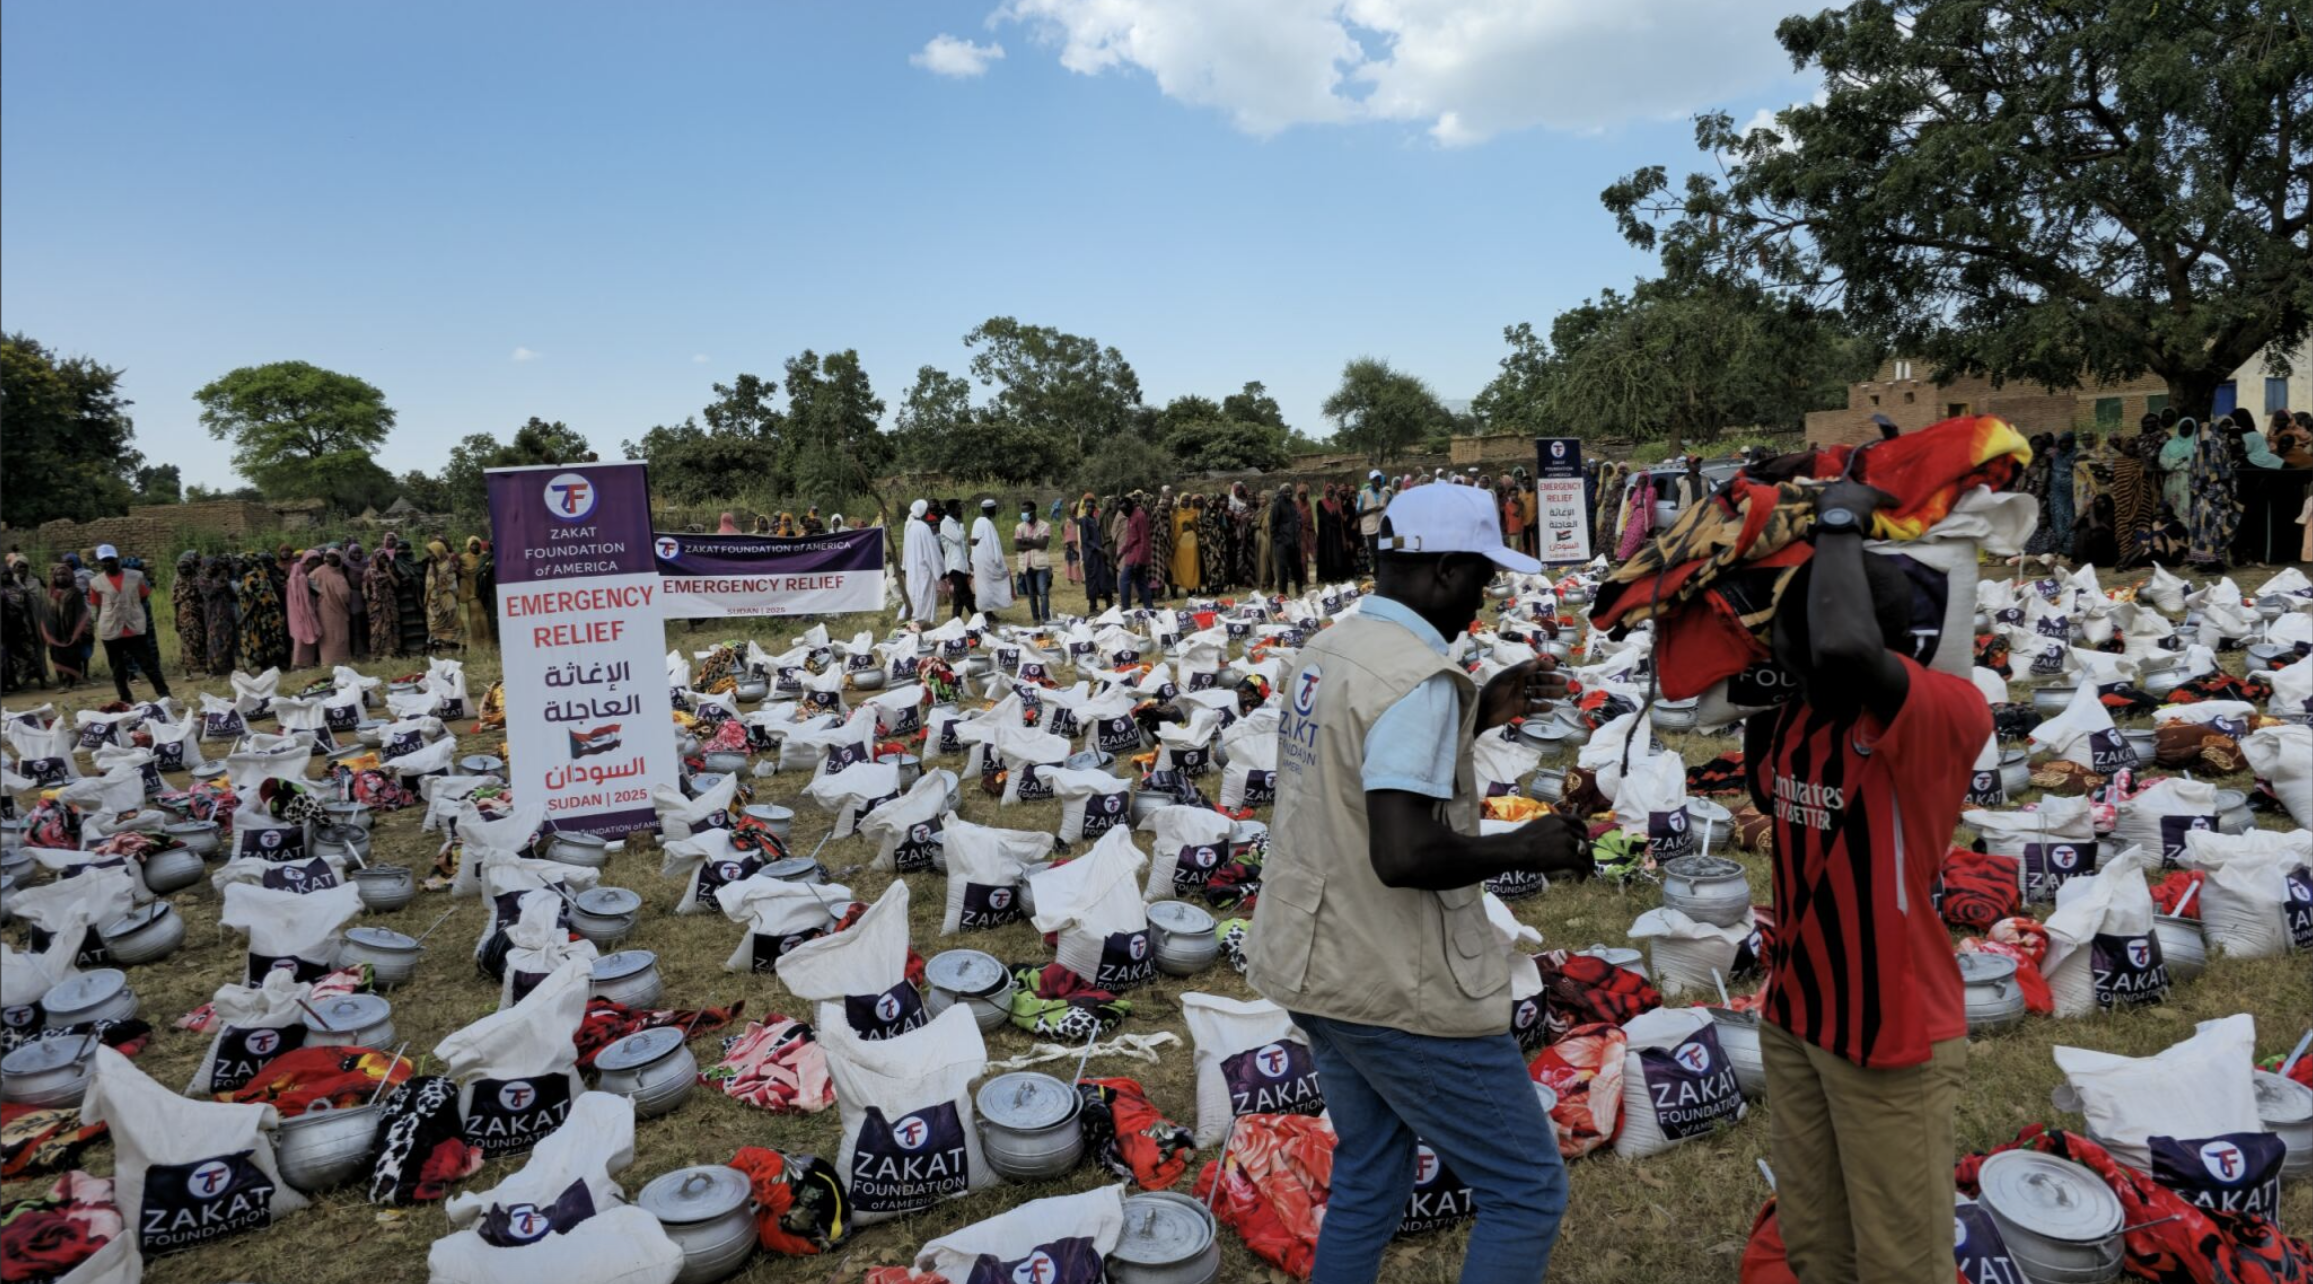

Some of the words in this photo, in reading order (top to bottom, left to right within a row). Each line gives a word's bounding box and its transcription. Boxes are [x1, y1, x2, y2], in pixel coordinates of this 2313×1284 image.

[550, 527, 597, 541] ZAKAT
[685, 545, 719, 554] ZAKAT
[721, 544, 791, 554] FOUNDATION
[806, 540, 851, 552] AMERICA
[525, 542, 625, 560] FOUNDATION
[535, 565, 550, 577] of
[552, 560, 618, 576] AMERICA
[663, 578, 780, 594] EMERGENCY
[785, 575, 845, 592] RELIEF
[506, 585, 653, 617] EMERGENCY
[727, 607, 759, 615] SUDAN
[766, 606, 786, 614] 2025
[533, 620, 624, 648] RELIEF
[545, 661, 630, 691] الإغاثة
[544, 694, 641, 725] العاجلة
[1100, 728, 1140, 746] ZAKAT
[545, 756, 645, 790] السودان
[548, 793, 603, 811] SUDAN
[614, 788, 648, 804] 2025
[1245, 787, 1276, 800] ZAK
[1963, 789, 2004, 805] AKAT
[896, 848, 932, 864] ZAK
[2093, 963, 2168, 992] ZAKAT
[858, 1007, 925, 1041] AKAT
[1233, 1071, 1319, 1115] ZAKAT
[1652, 1065, 1737, 1108] ZAKAT
[465, 1098, 571, 1136] ZAKAT
[1658, 1092, 1742, 1126] FOUNDATION
[854, 1147, 965, 1181] ZAKAT
[853, 1175, 966, 1197] FOUNDATION
[2194, 1180, 2274, 1212] AKAT
[142, 1185, 274, 1234] ZAKAT
[871, 1199, 886, 1211] of
